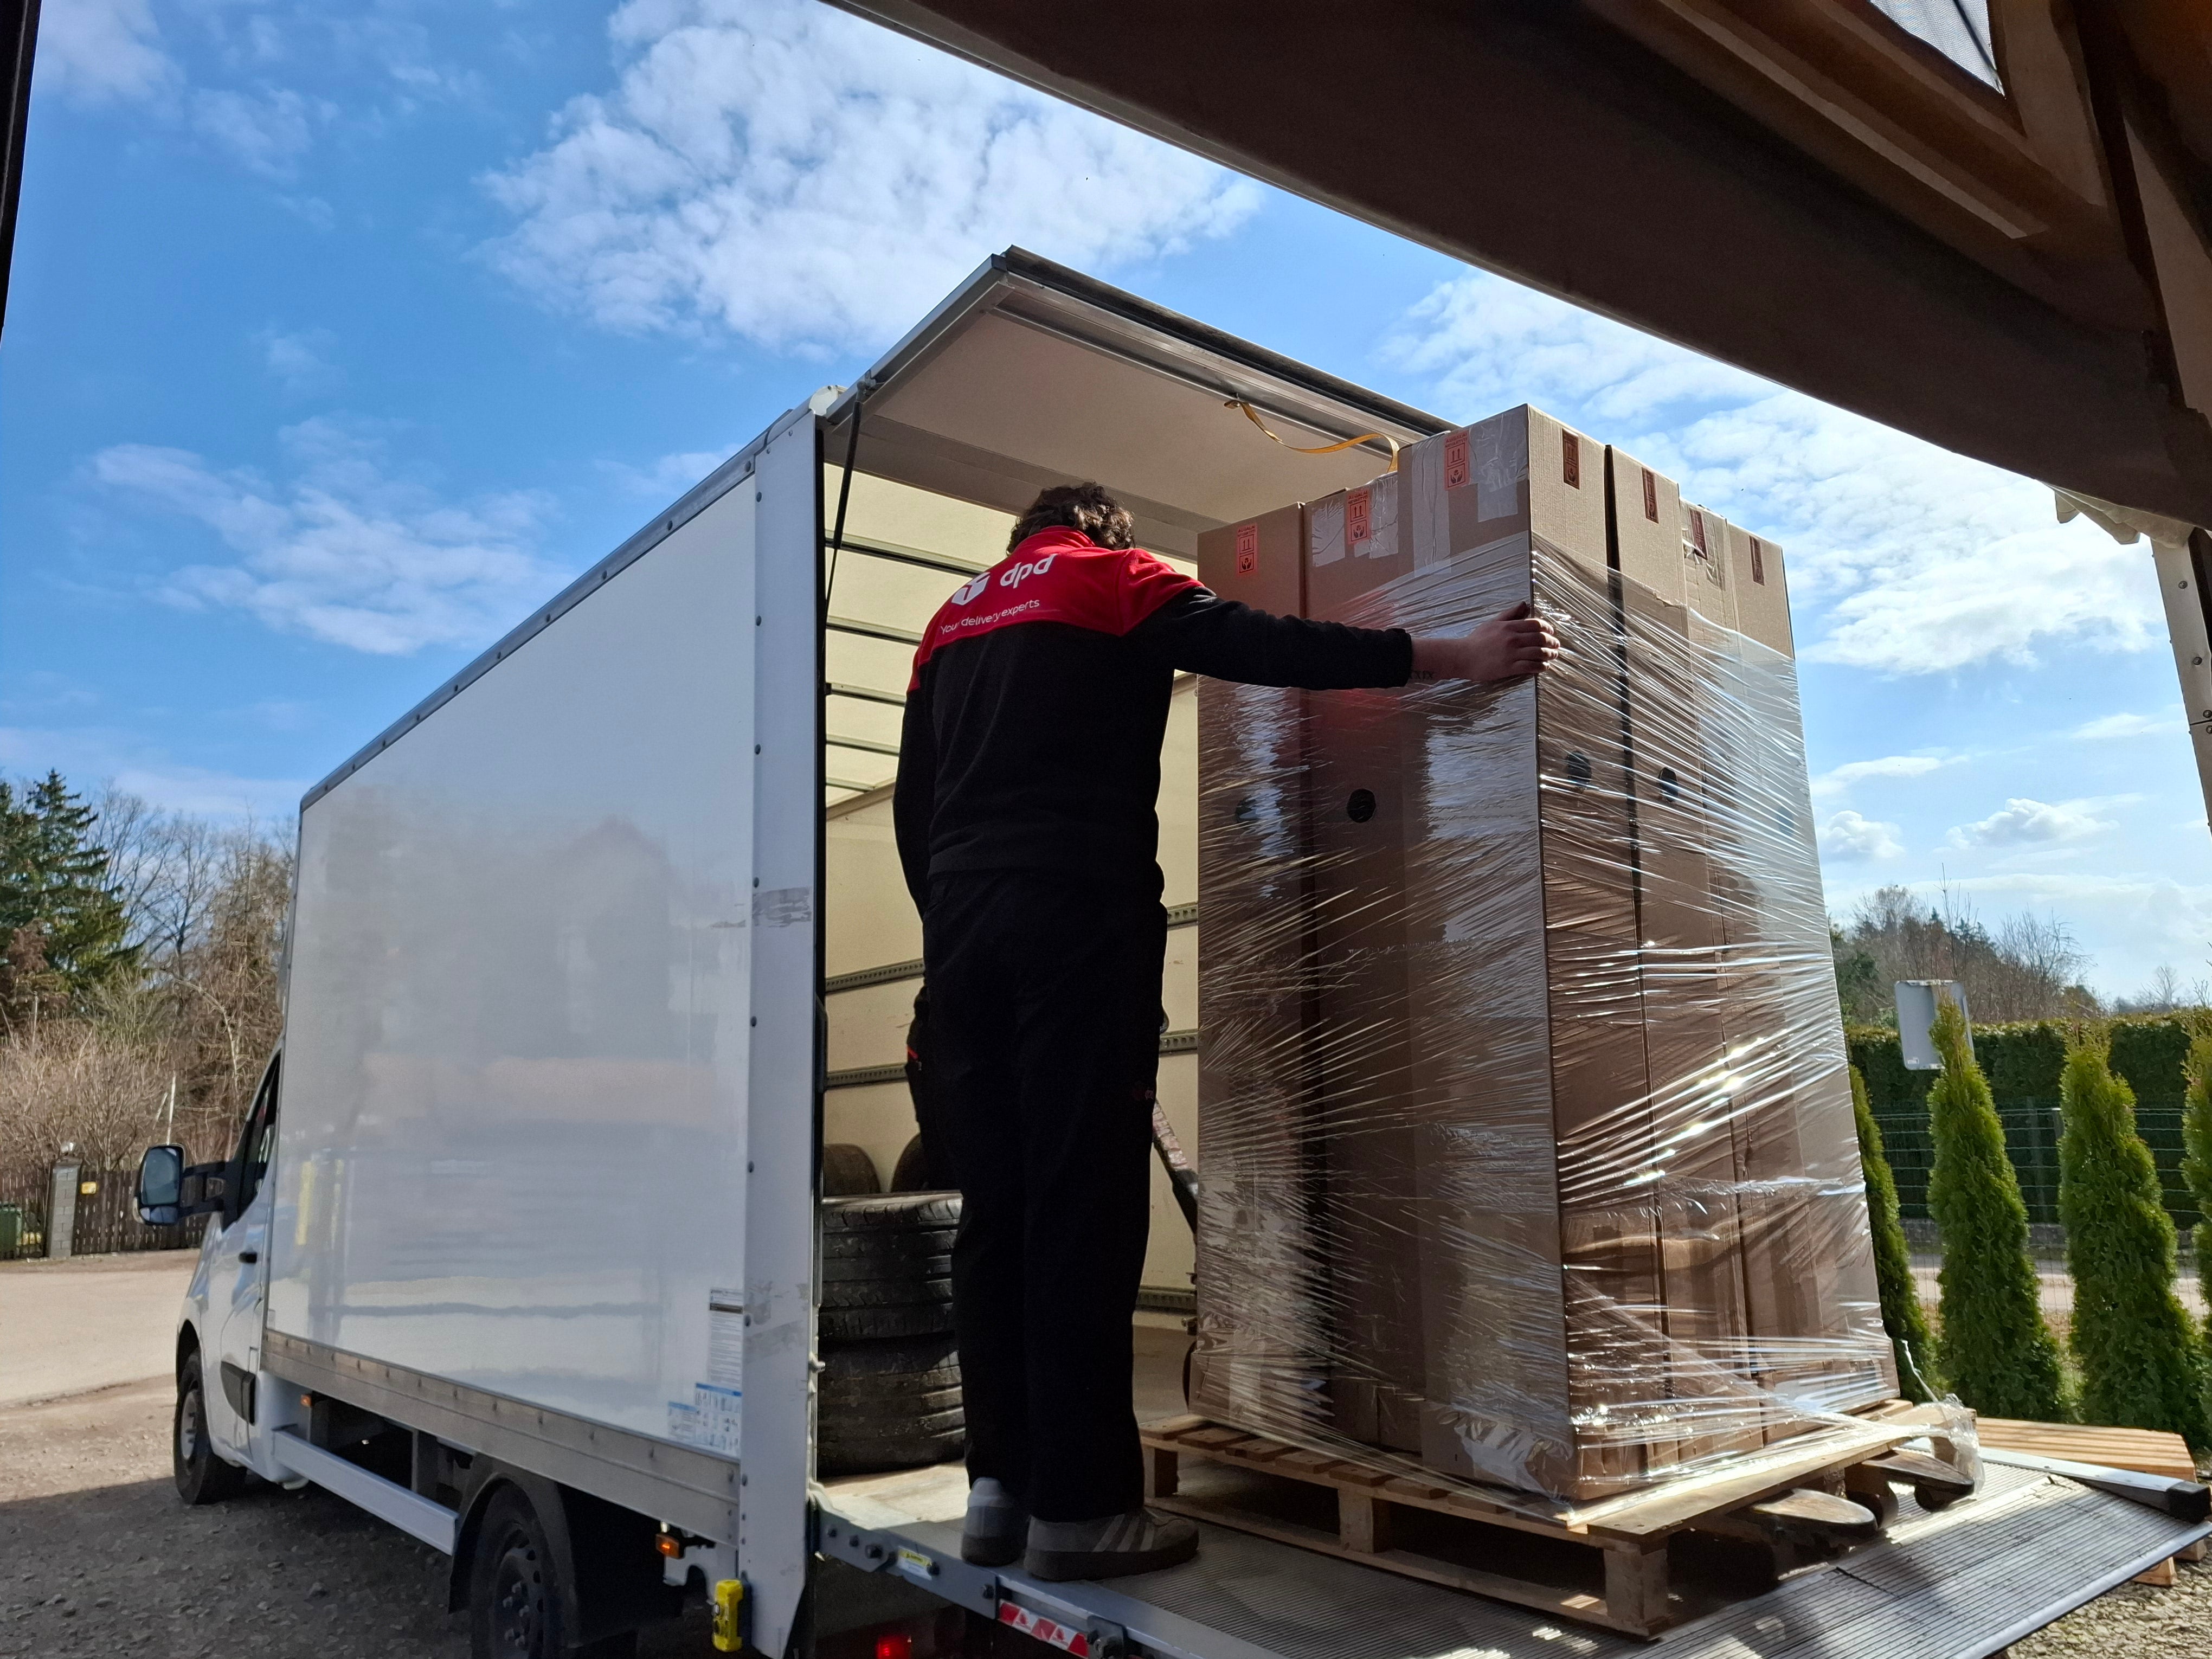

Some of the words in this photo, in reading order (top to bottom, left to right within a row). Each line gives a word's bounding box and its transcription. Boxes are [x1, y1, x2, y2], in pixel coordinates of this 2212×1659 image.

[1000, 553, 1058, 589] dpd
[940, 622, 960, 635] Your
[961, 612, 1001, 626] delivery
[1001, 600, 1040, 616] experts
